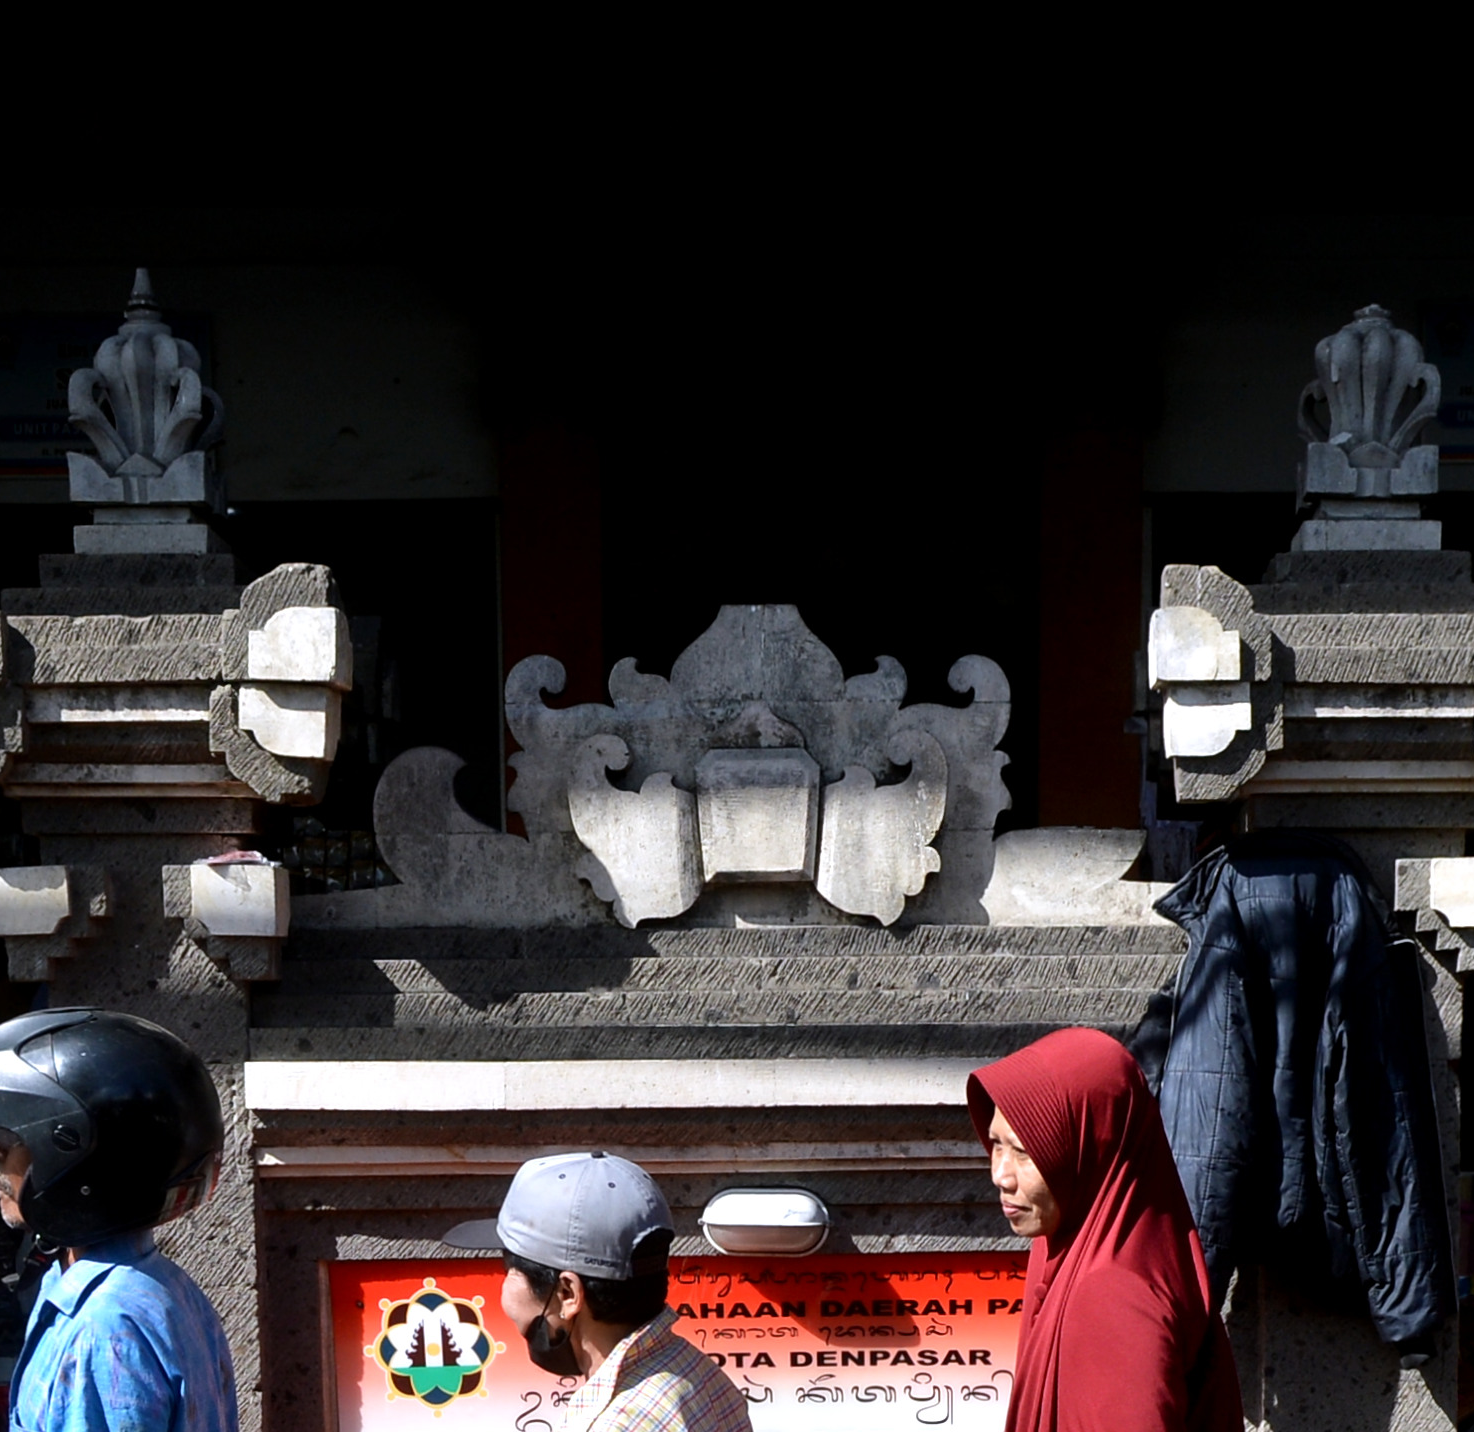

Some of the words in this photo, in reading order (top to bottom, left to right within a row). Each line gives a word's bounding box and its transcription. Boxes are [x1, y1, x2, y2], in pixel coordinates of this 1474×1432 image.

[46, 399, 68, 410] JUA
[676, 1300, 807, 1319] AHAAN
[819, 1299, 974, 1318] DAERAH
[988, 1299, 1024, 1316] PA
[708, 1351, 777, 1369] OTA
[789, 1349, 993, 1368] DENPASAR
